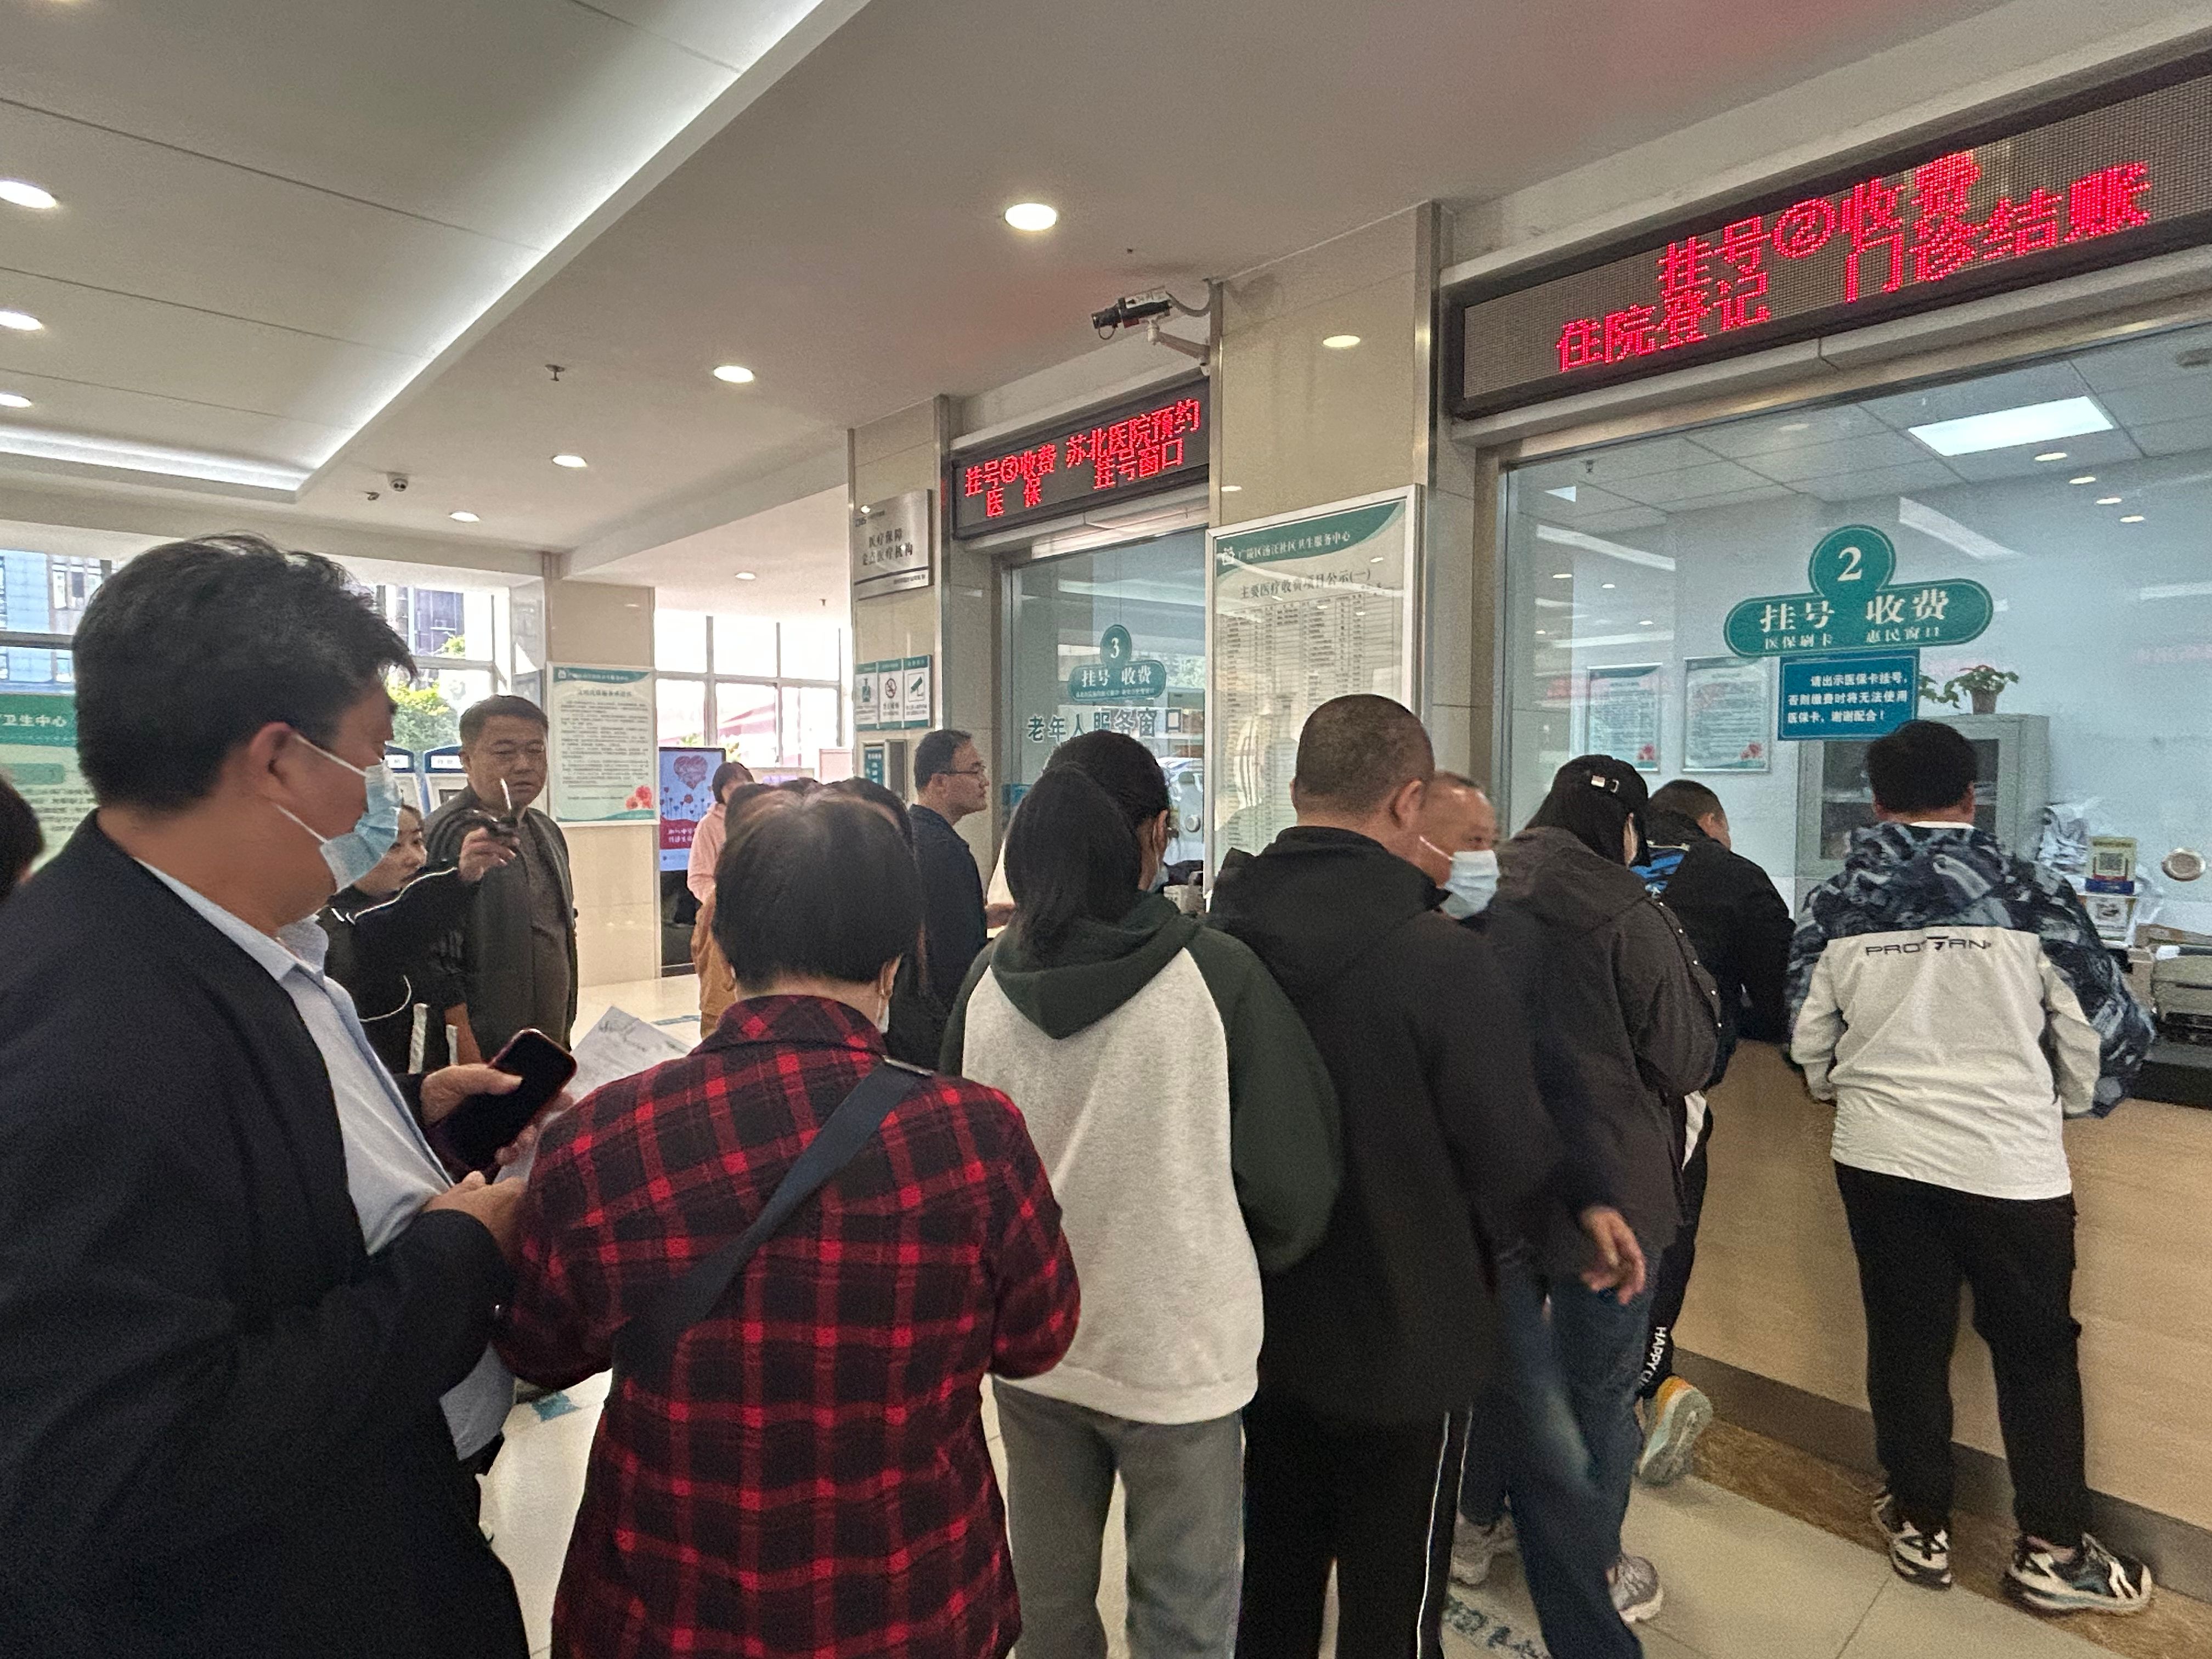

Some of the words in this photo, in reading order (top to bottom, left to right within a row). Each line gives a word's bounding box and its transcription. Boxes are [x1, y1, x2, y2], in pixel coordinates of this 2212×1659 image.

[1556, 270, 1771, 372] 住院登记
[1845, 160, 2152, 303] 门诊结账
[1065, 398, 1201, 469] 苏北医院预约
[1094, 437, 1184, 490] 挂号窗口
[1837, 547, 1863, 582] 2
[1759, 600, 1835, 633] 挂号
[1865, 588, 1949, 625] 收费
[1110, 637, 1120, 658] 3
[1765, 633, 1834, 651] 医保刷卡
[1866, 626, 1940, 643] 惠民窗口
[1081, 668, 1110, 688] 挂号
[1121, 664, 1152, 686] 收费
[1028, 707, 1182, 742] 老年人服务窗口
[1646, 1327, 1667, 1371] HAPPY
